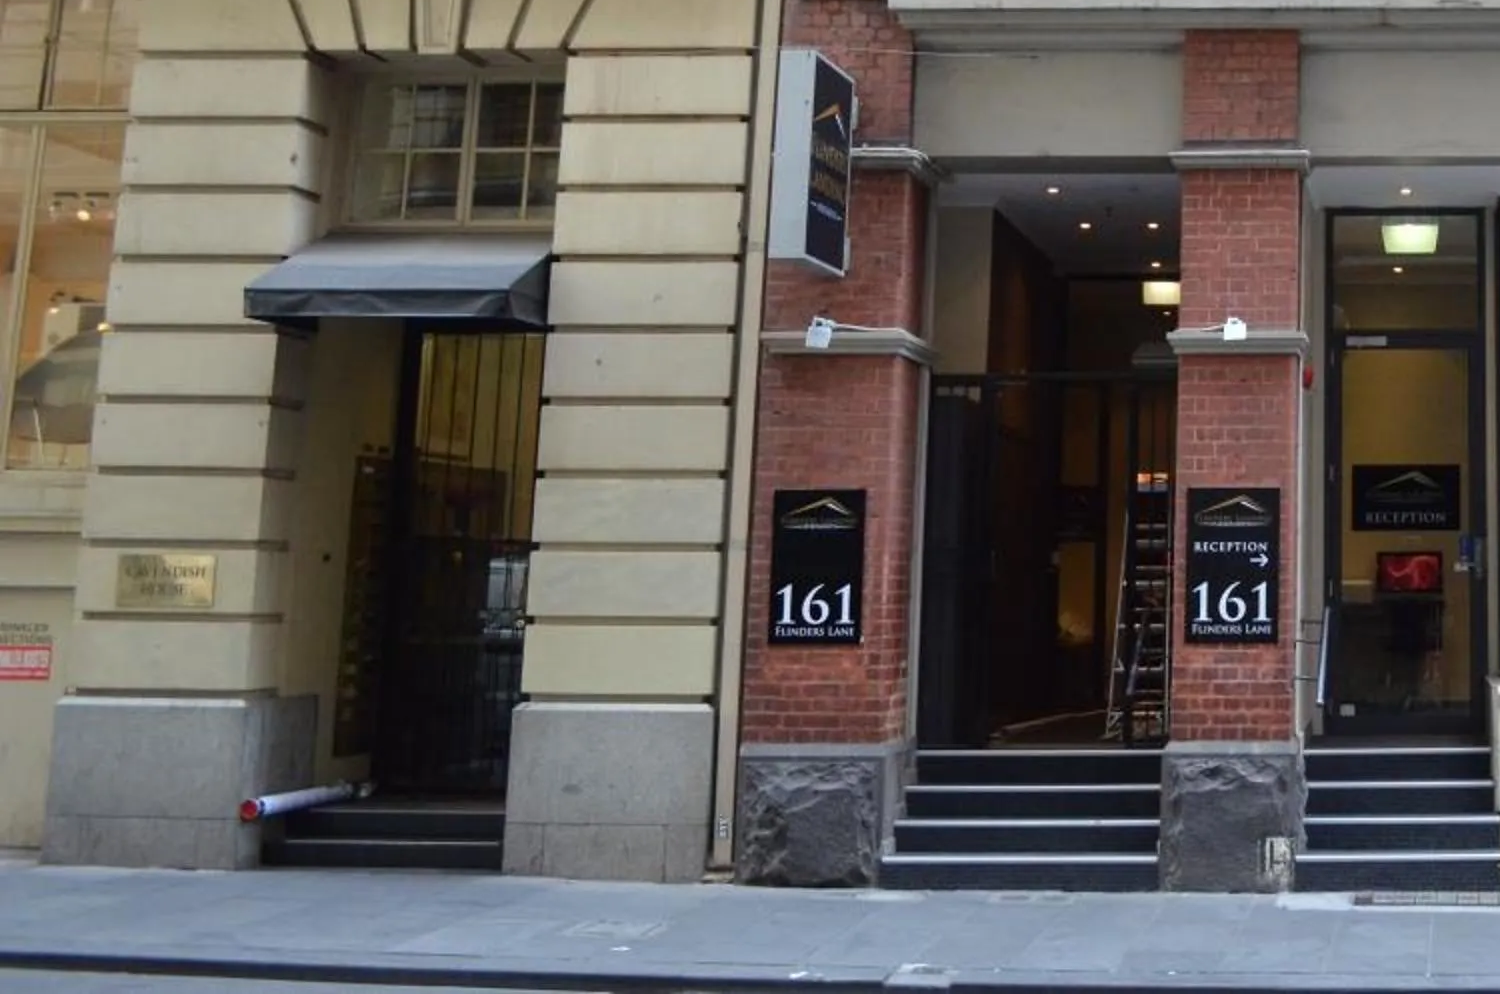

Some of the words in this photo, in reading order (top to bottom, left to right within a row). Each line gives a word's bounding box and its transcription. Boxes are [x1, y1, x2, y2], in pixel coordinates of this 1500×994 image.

[1365, 511, 1446, 524] RECEPTION
[1193, 540, 1269, 552] RECEPTION
[775, 582, 855, 625] 161
[1191, 580, 1272, 623] 161
[774, 625, 825, 638] FLINDERS
[827, 625, 855, 638] LANE
[1191, 622, 1243, 636] FLINDERS
[1245, 622, 1272, 636] LANE
